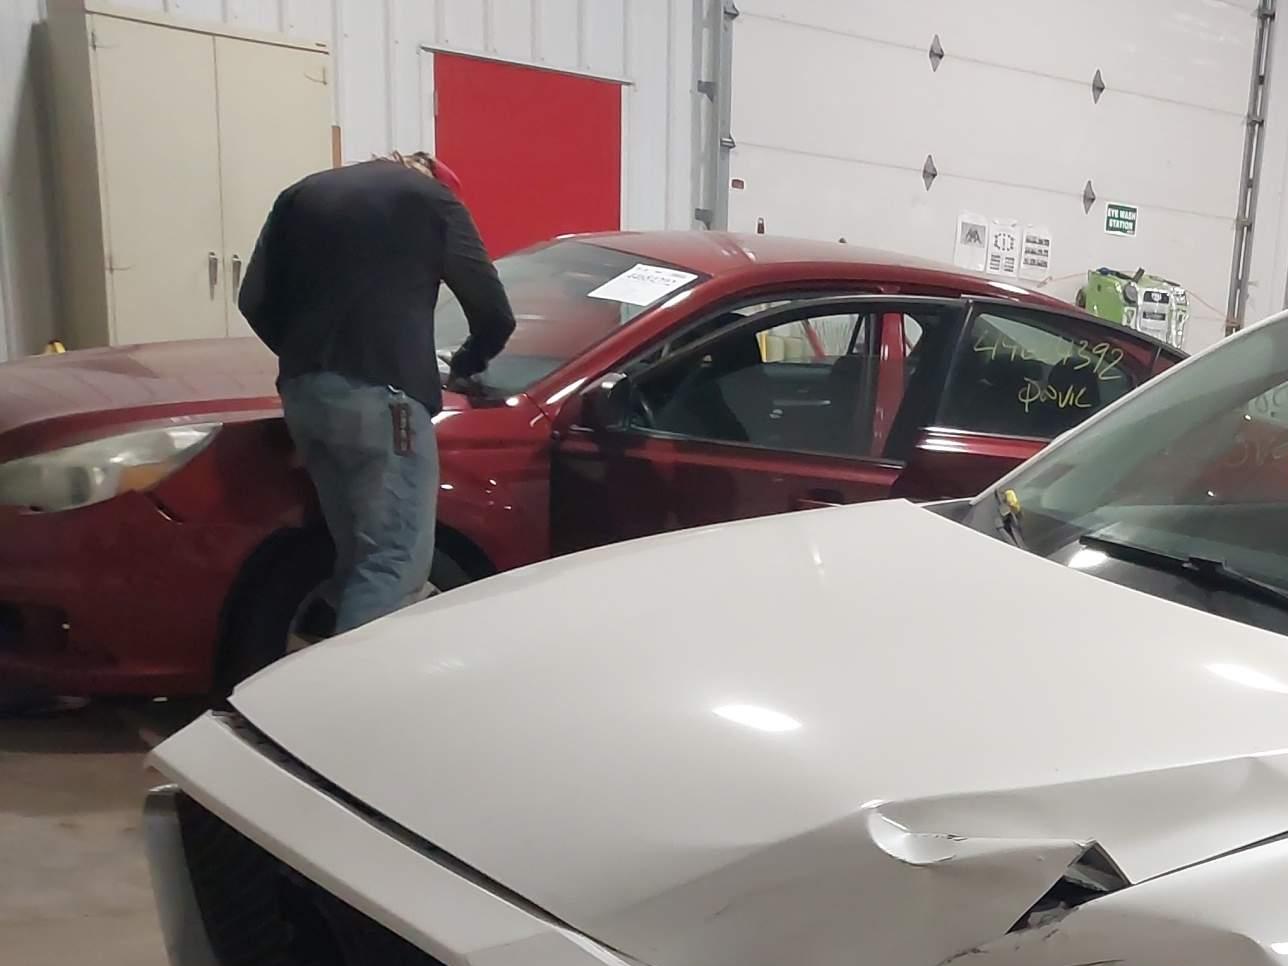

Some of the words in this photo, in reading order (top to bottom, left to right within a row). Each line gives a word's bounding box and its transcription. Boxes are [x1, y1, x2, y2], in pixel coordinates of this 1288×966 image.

[1107, 207, 1119, 218] EYE
[1120, 210, 1136, 221] WASH
[1108, 218, 1134, 230] STATION
